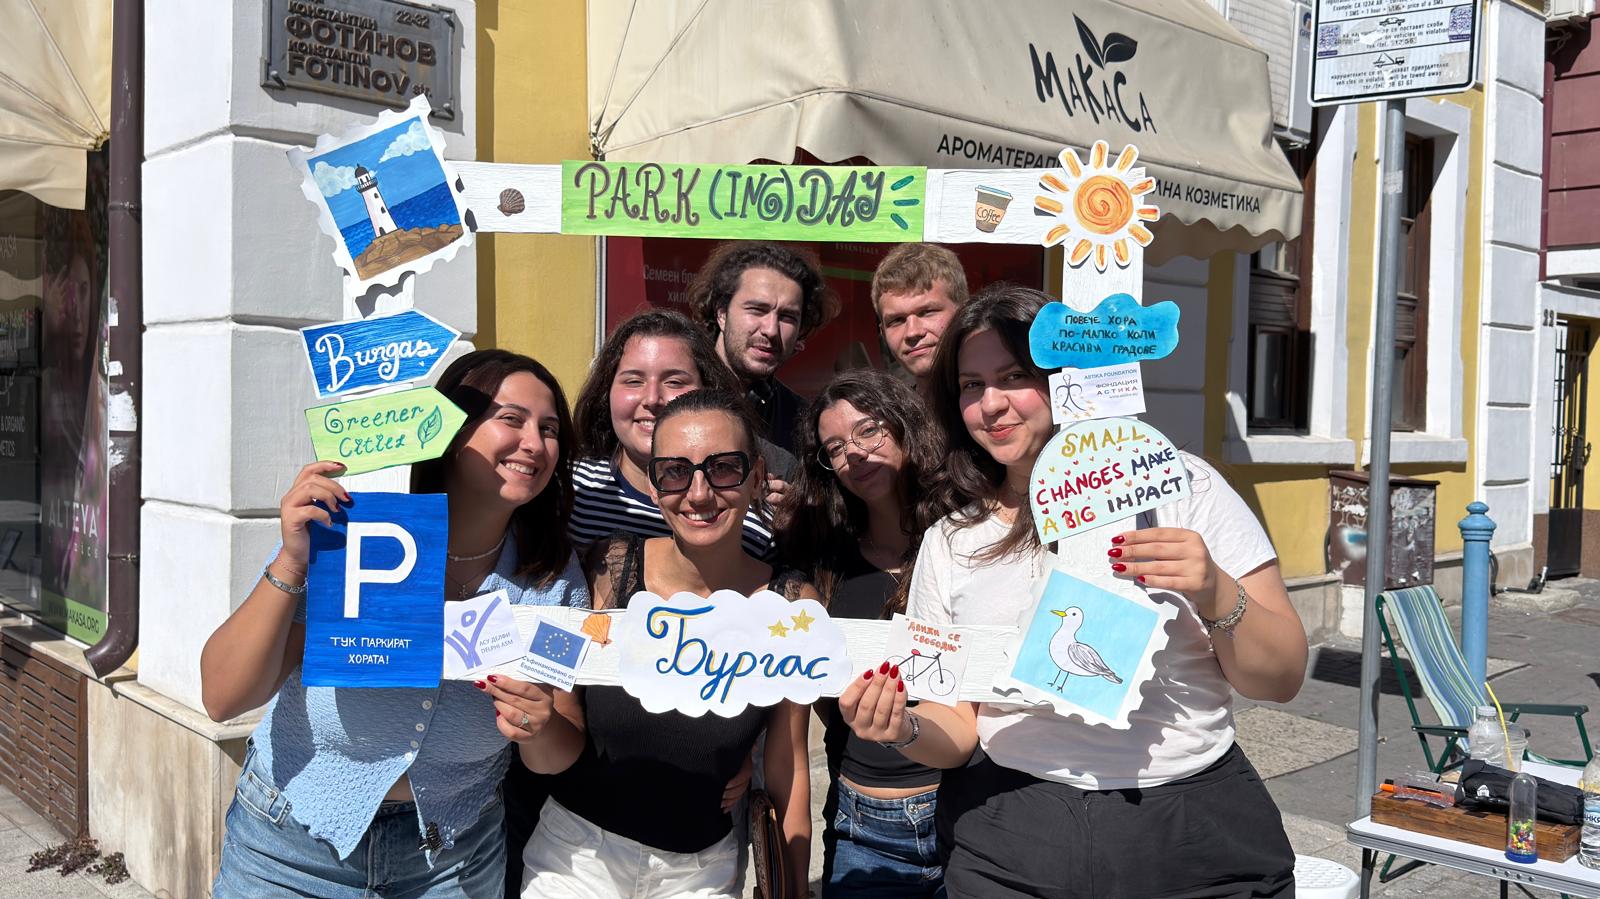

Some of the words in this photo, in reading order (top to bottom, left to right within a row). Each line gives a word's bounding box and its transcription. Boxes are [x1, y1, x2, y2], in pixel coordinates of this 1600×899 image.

[288, 0, 379, 31] КОНСТАНТИН
[284, 15, 437, 66] ФОТИНОВ
[288, 38, 373, 67] KONSTANTIN
[287, 52, 411, 95] FOTINOV
[412, 83, 434, 98] str.
[937, 133, 1062, 169] АРОМАТЕРАП
[1185, 185, 1261, 213] КОЗМЕТИКА
[643, 264, 680, 283] Семеен
[1065, 315, 1100, 325] ПОВЕЧЕ
[1108, 315, 1137, 325] ХОРА
[1058, 329, 1118, 340] ПО-МАЛКО
[1127, 330, 1156, 340] КОЛИ
[1052, 341, 1102, 353] КРАСИВИ
[1112, 345, 1158, 357] ГРАДОВЕ
[315, 333, 439, 392] Burgas
[1104, 369, 1137, 377] FOUNDATION
[1096, 379, 1138, 388] ФОНДАЦИЯ
[1097, 386, 1138, 396] АСТИКА
[324, 405, 424, 434] Greener
[339, 433, 406, 457] Cities
[1061, 425, 1146, 457] SMALL
[1036, 462, 1125, 506] CHANGES
[1131, 447, 1176, 476] MAKE
[48, 498, 99, 538] ALTEYA
[1042, 517, 1059, 536] A
[1061, 506, 1096, 529] BIG
[1107, 476, 1183, 513] IMPACT
[344, 522, 418, 618] P
[330, 636, 356, 647] ТУК
[361, 637, 412, 649] ПАРКИРАТ
[481, 643, 500, 654] DELPHI
[501, 639, 514, 648] ASM
[948, 633, 961, 642] СЕ
[348, 654, 390, 665] ХОРАТА!
[521, 655, 568, 678] Съфинансирано
[647, 605, 830, 703] Бургас
[520, 662, 557, 681] Европейския
[557, 678, 573, 687] съюз
